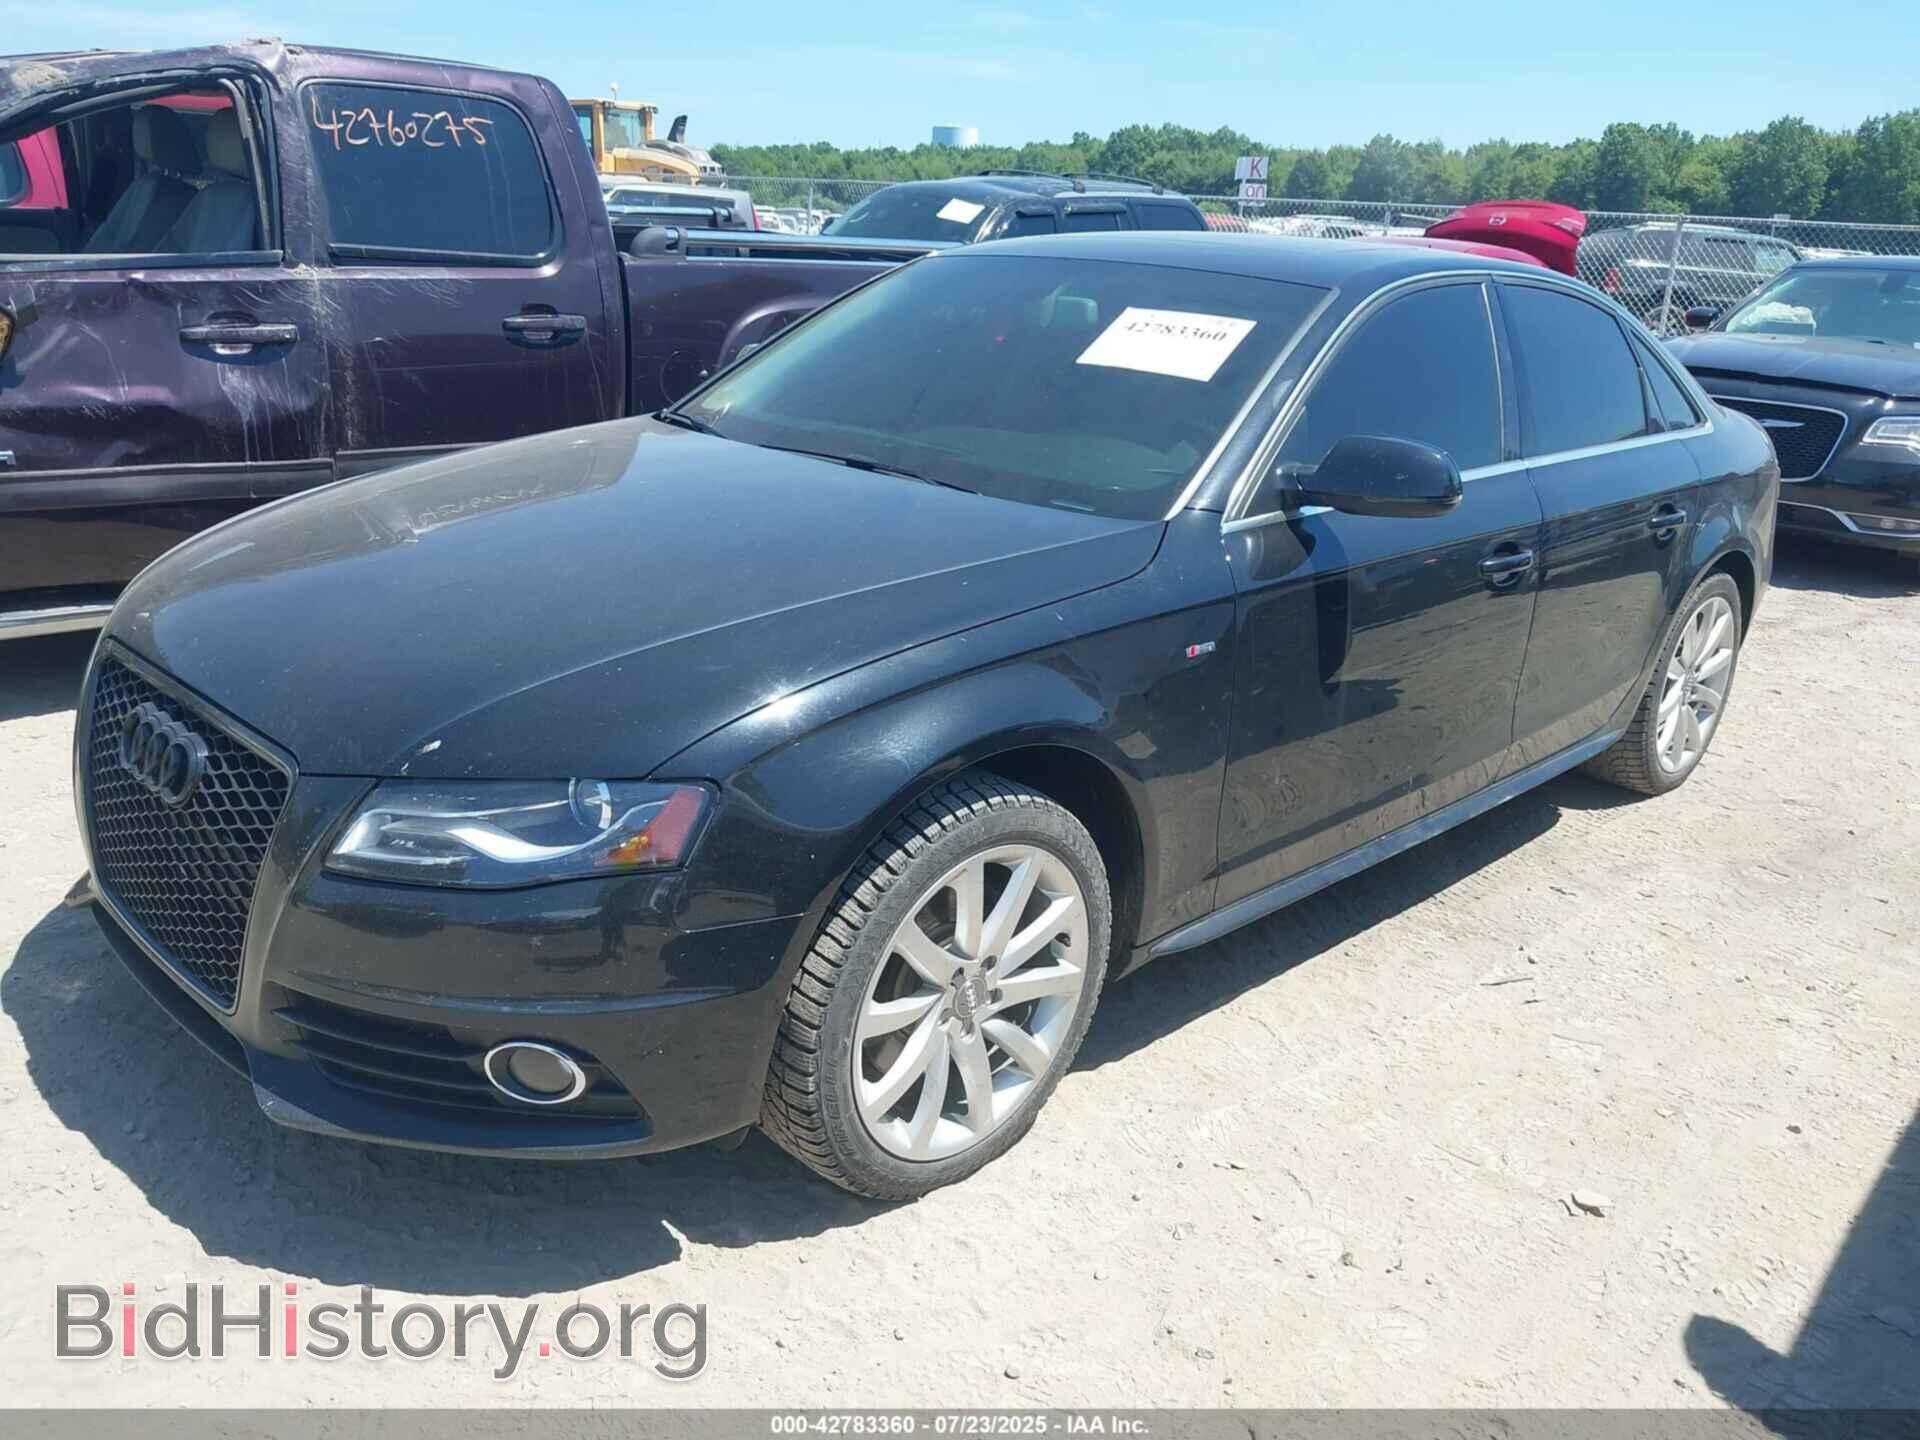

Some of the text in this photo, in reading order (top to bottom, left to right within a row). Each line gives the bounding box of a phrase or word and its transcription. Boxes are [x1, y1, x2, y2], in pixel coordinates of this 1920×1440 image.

[311, 95, 494, 150] 42760275
[1250, 157, 1264, 177] K
[1123, 321, 1228, 341] 42783360
